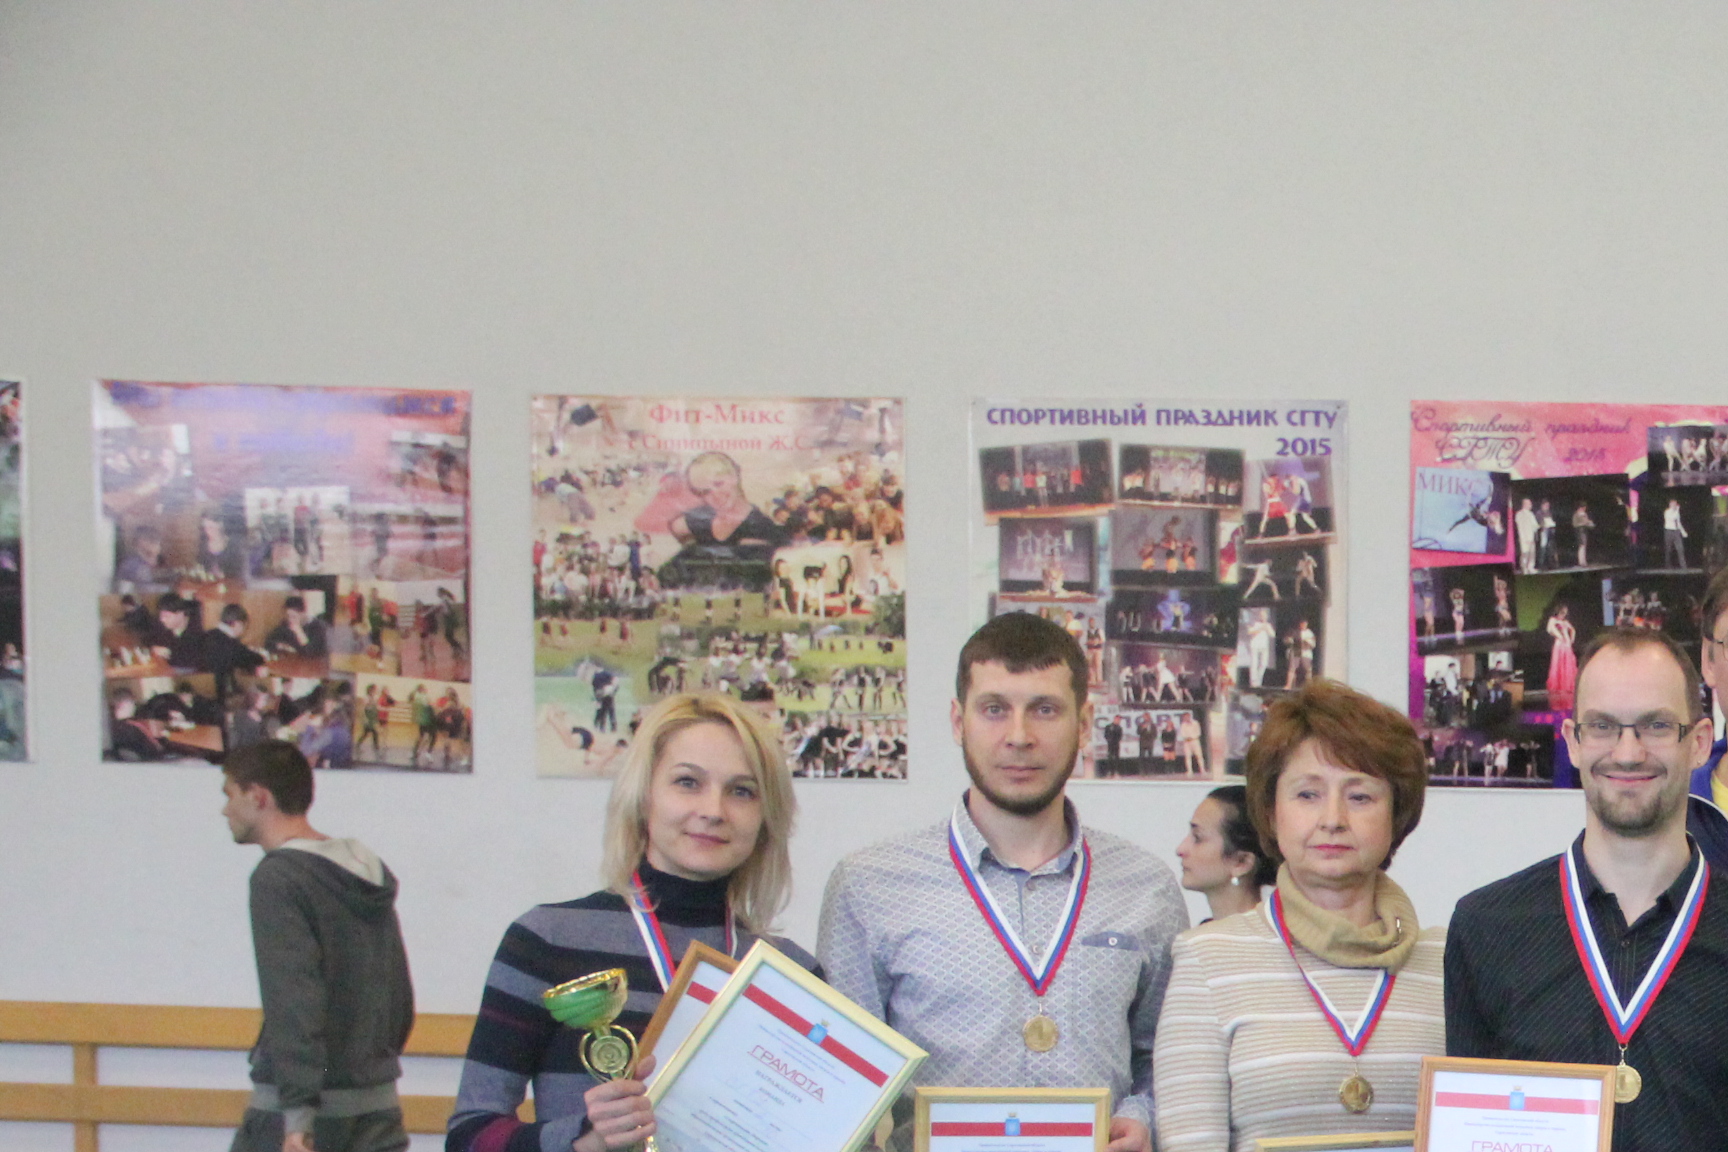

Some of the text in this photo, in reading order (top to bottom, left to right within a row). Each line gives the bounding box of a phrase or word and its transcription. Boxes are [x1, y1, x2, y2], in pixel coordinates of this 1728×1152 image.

[650, 404, 785, 424] Фит-Микс
[986, 403, 1338, 429] СПОРТИВНЫЙ ПРАЗДНИК СГТУ
[1275, 437, 1333, 457] 2015
[751, 1044, 826, 1101] ГРАМОТА
